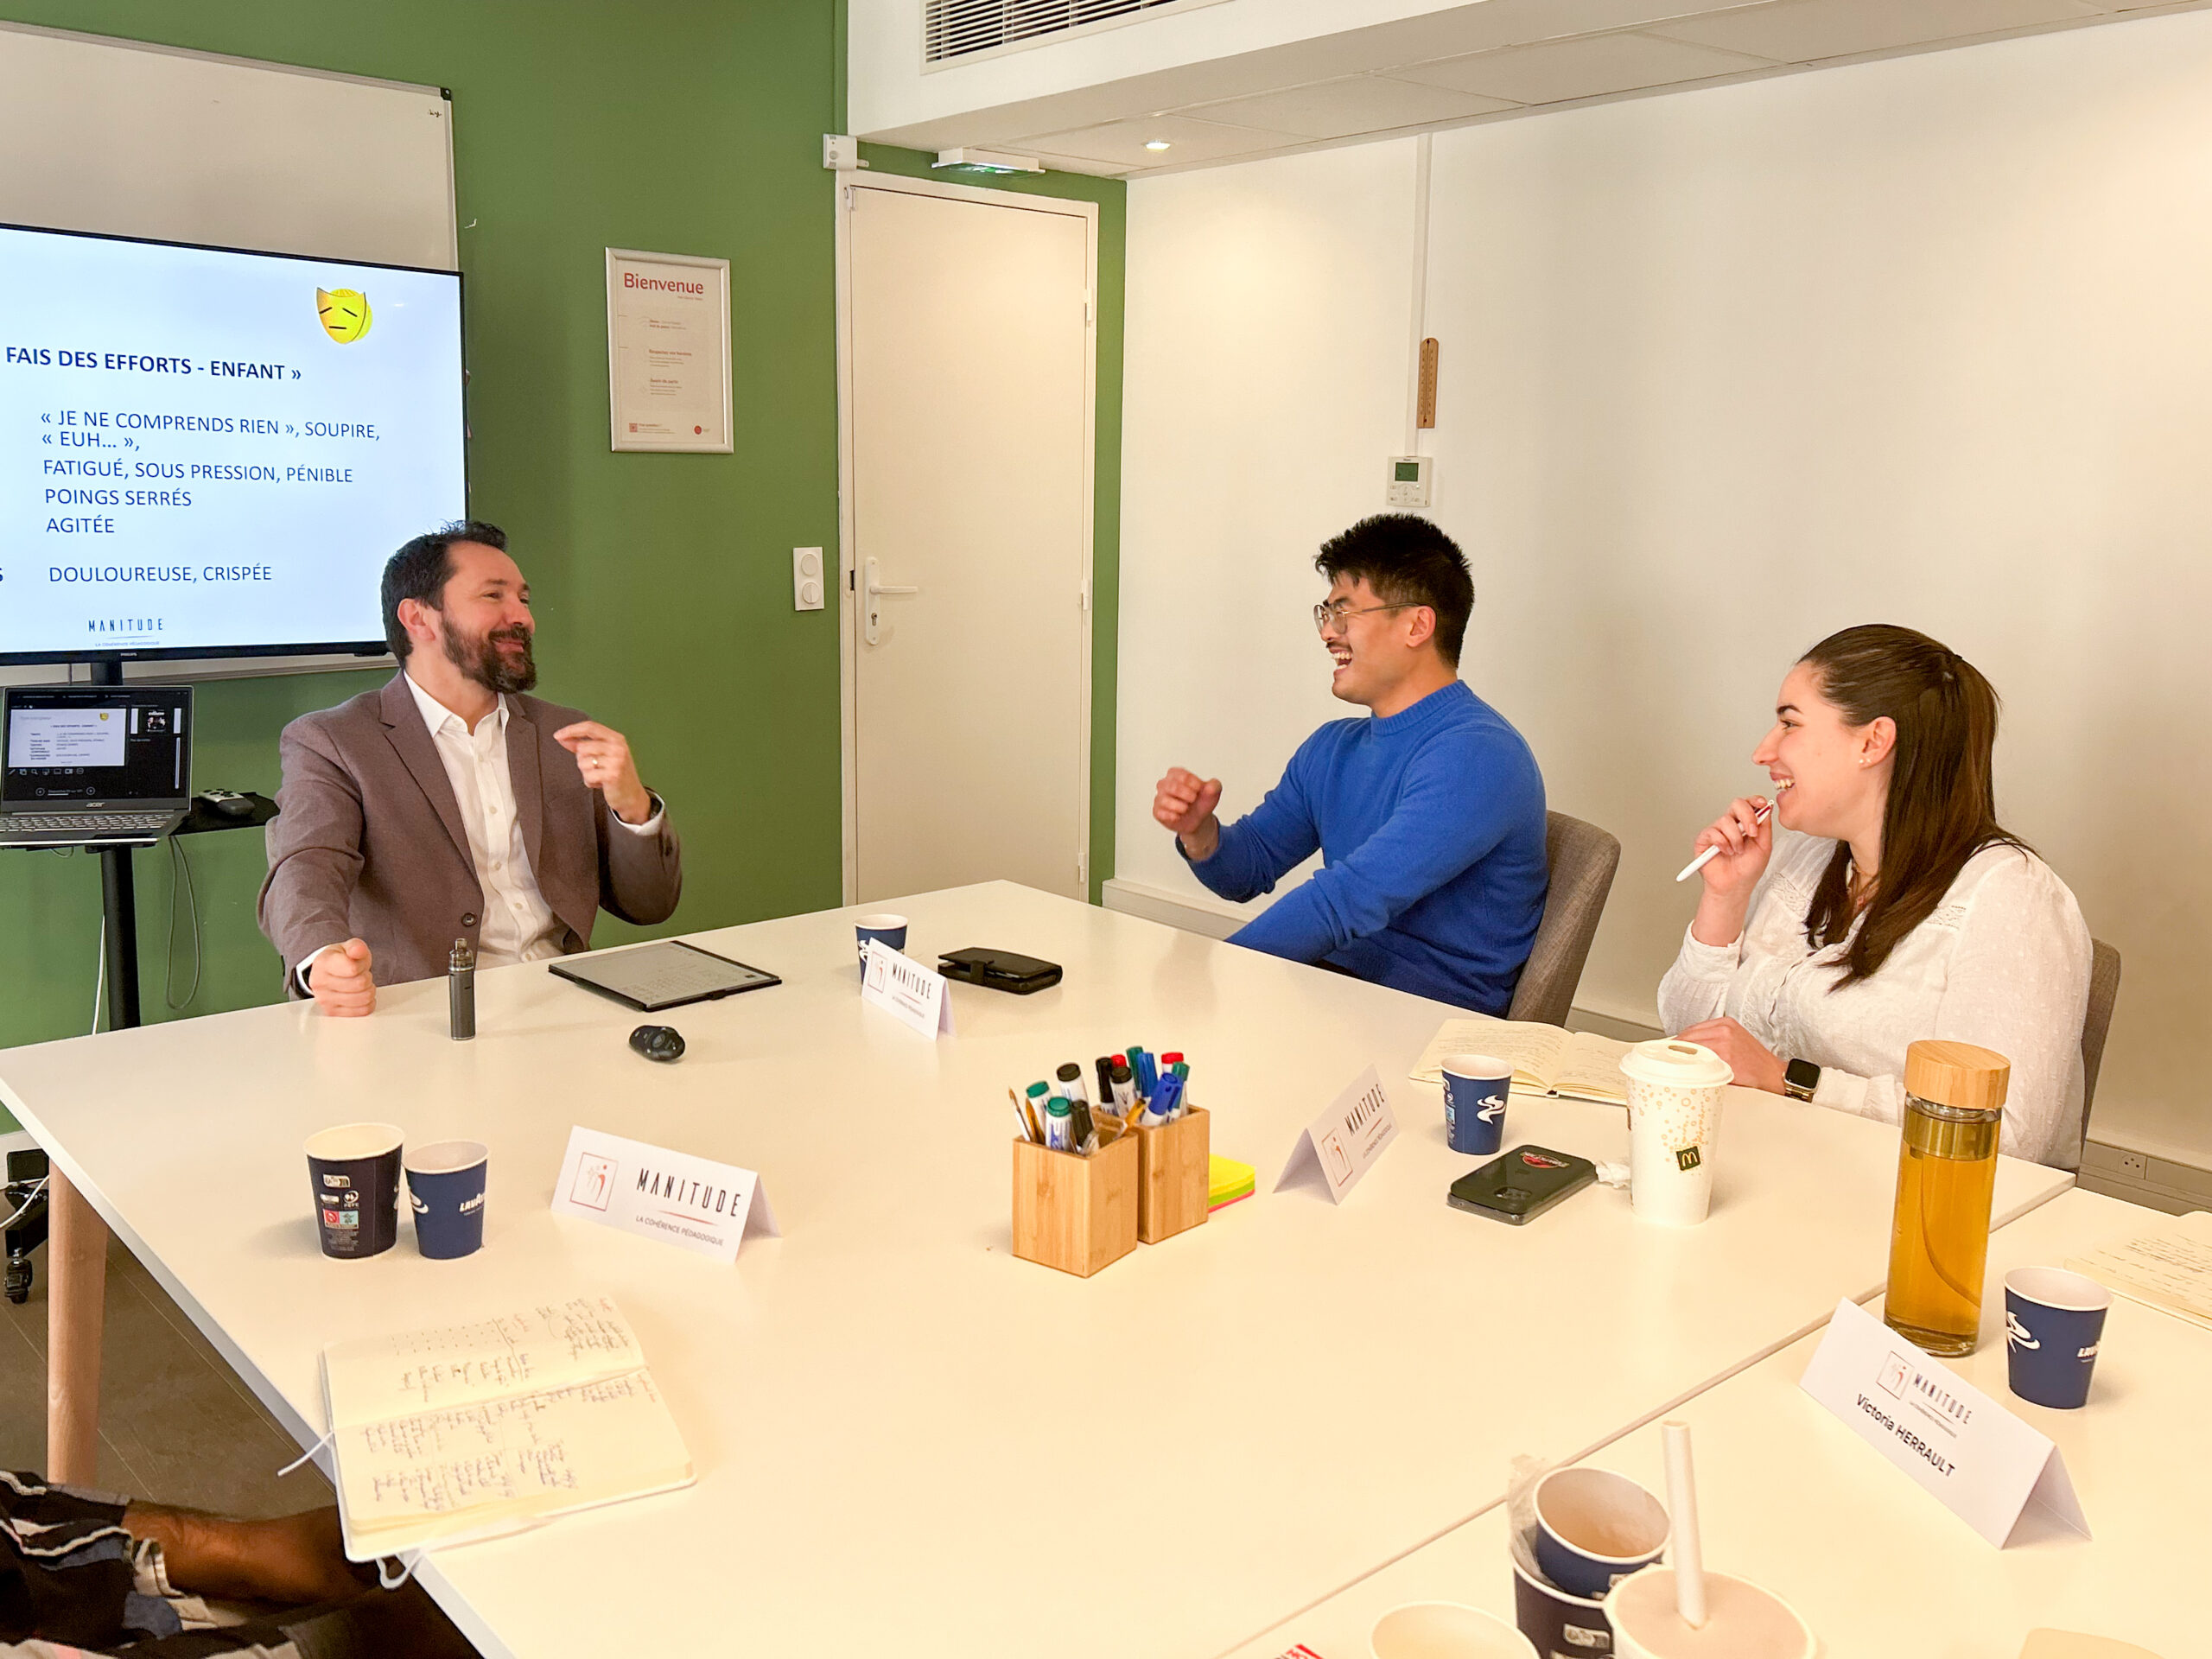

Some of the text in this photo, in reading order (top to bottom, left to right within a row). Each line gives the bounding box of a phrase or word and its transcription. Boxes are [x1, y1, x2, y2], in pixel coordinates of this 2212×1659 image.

[624, 272, 704, 295] Bienvenue
[6, 346, 51, 365] FAIS
[58, 350, 98, 368] DES
[105, 353, 192, 374] EFFORTS
[210, 360, 285, 379] ENFANT
[58, 410, 77, 426] JE
[84, 411, 110, 427] NE
[116, 412, 234, 432] COMPRENDS
[239, 419, 279, 434] RIEN
[305, 422, 380, 441] SOUPIRE,
[60, 431, 117, 448] EUH...
[43, 458, 353, 483] FATIGUÉ, SOUS PRESSION, PÉNIBLE
[45, 487, 192, 505] POINGS SERRÉS
[46, 514, 115, 533] AGITÉE
[49, 562, 272, 583] DOULOUREUSE, CRISPÉE
[88, 618, 163, 632] MANITUDE
[892, 963, 931, 1000] MANITUDE
[1344, 1084, 1384, 1136] MANITUDE
[636, 1167, 741, 1217] MANITUDE
[644, 1217, 680, 1234] COHÉRENCE
[1913, 1373, 1972, 1424] MANITUDE
[1857, 1393, 1895, 1431] Victoria
[1895, 1425, 1955, 1477] HERRAULT
